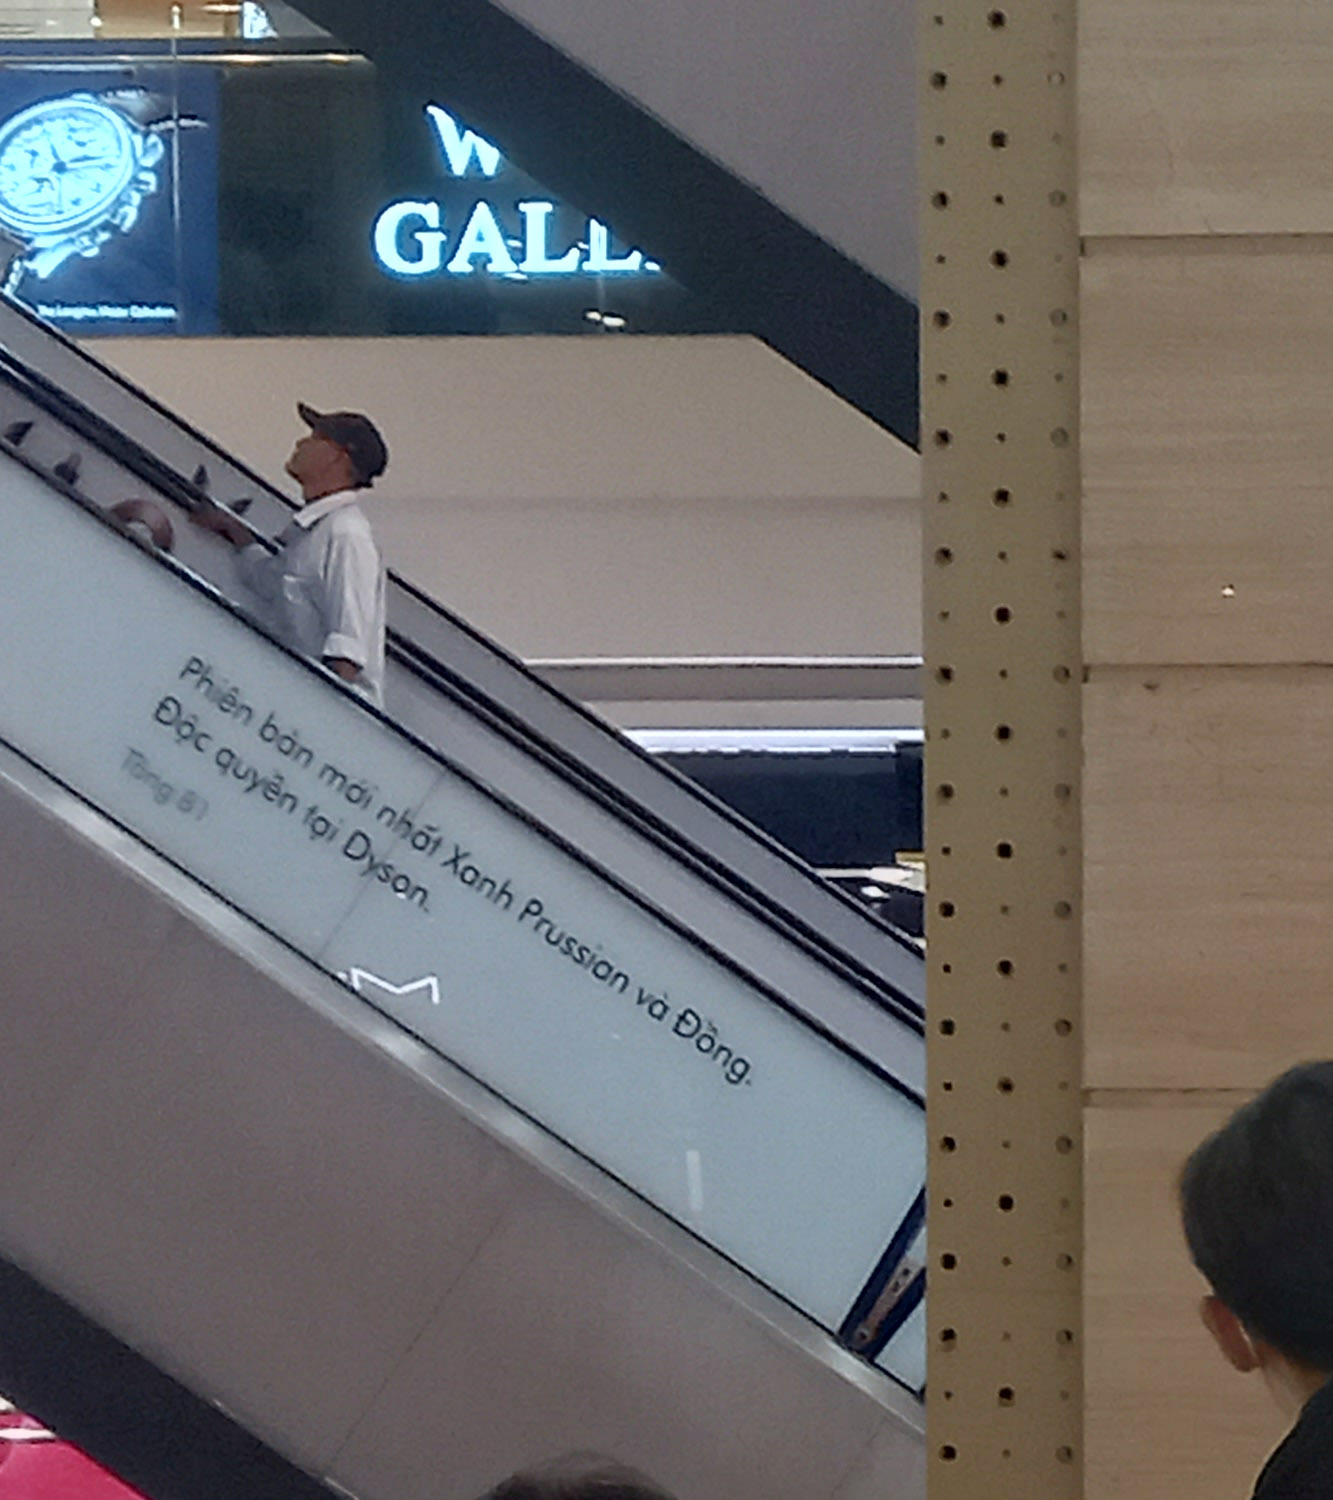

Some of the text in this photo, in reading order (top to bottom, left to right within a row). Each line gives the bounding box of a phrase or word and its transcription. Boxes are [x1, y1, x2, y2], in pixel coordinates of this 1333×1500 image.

[374, 201, 660, 275] GALL
[152, 695, 213, 753] Độc
[215, 747, 298, 814] quyền
[179, 656, 252, 724] Phiên
[377, 803, 443, 856] nhất
[442, 845, 514, 911] Xanh
[518, 898, 630, 994] Prussian
[636, 987, 669, 1021] và
